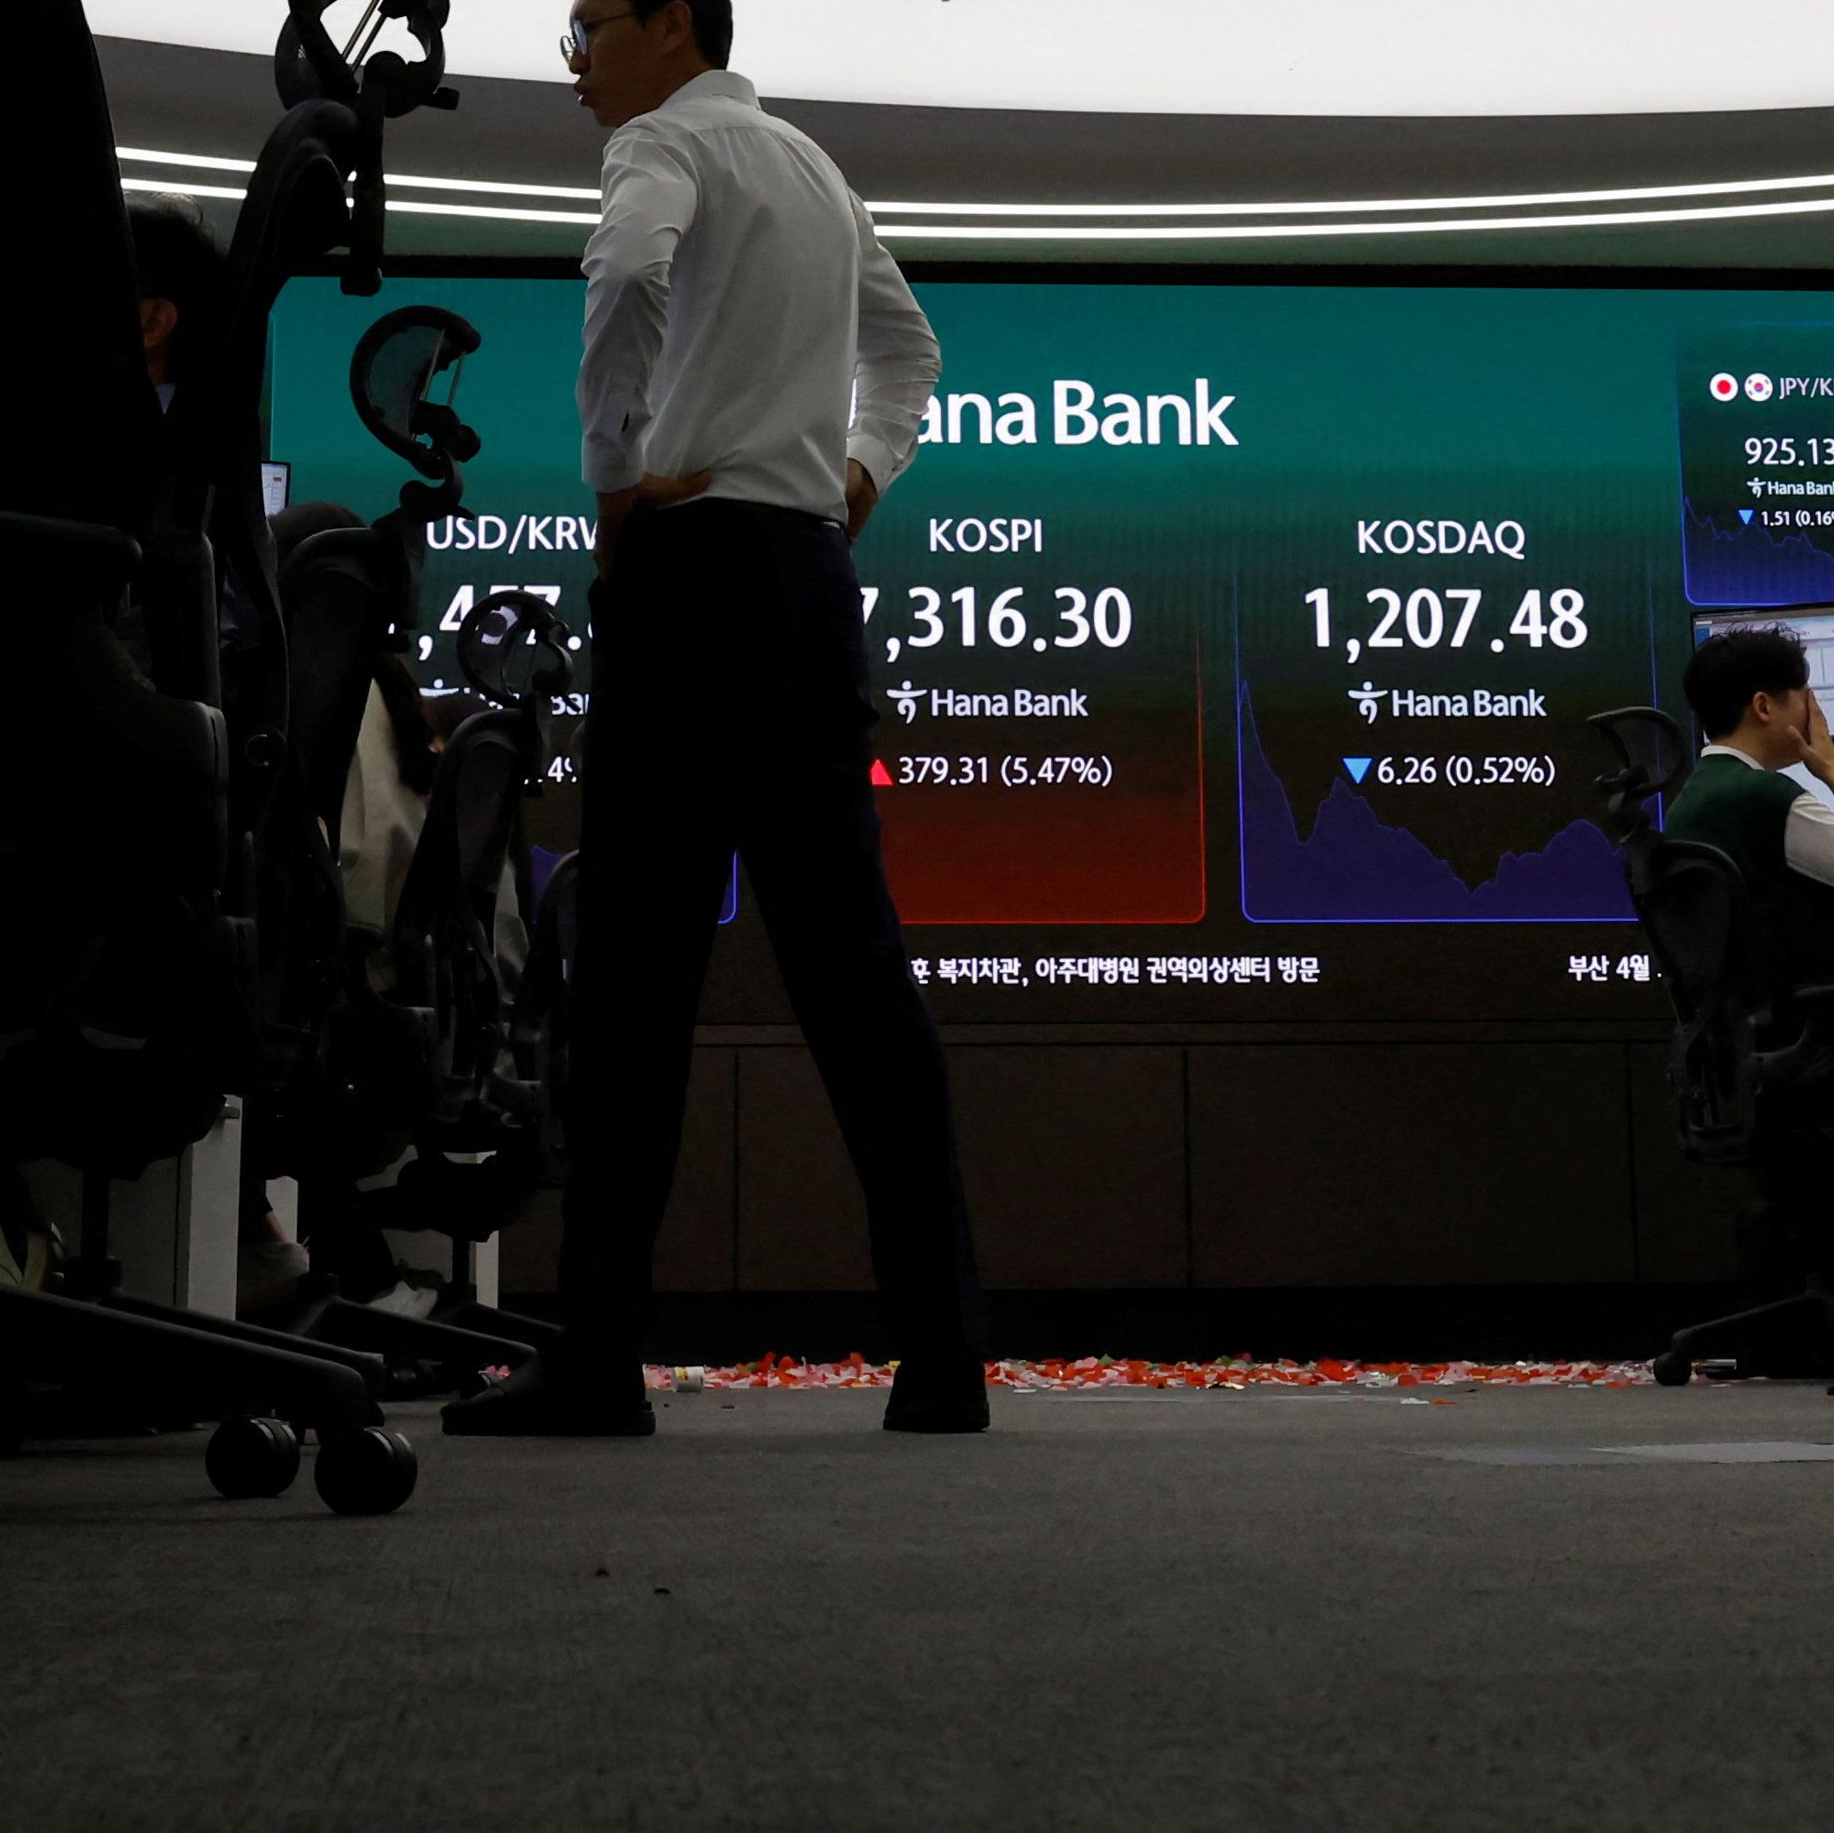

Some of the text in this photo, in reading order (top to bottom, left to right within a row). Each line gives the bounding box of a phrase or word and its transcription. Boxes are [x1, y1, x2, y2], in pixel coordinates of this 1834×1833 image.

[917, 377, 1240, 446] ana Bank
[1767, 480, 1805, 495] Hana
[1761, 510, 1790, 527] 1.51
[929, 517, 1043, 553] KOSPI
[1357, 519, 1526, 560] KOSDAQ
[1305, 587, 1588, 664] 1,207.48
[931, 688, 1089, 717] Hana Bank
[1392, 688, 1547, 717] Hana Bank
[899, 755, 1113, 787] 379.31 (5.47%)
[1377, 755, 1556, 787] 6.26 (0.52%)
[937, 956, 1029, 987] 복지차관,
[1035, 956, 1140, 984] 아주대병원
[1145, 956, 1271, 984] 권역외상센터
[1277, 956, 1321, 984] 방문
[1567, 954, 1610, 982] 부산
[1615, 954, 1651, 982] 4월
